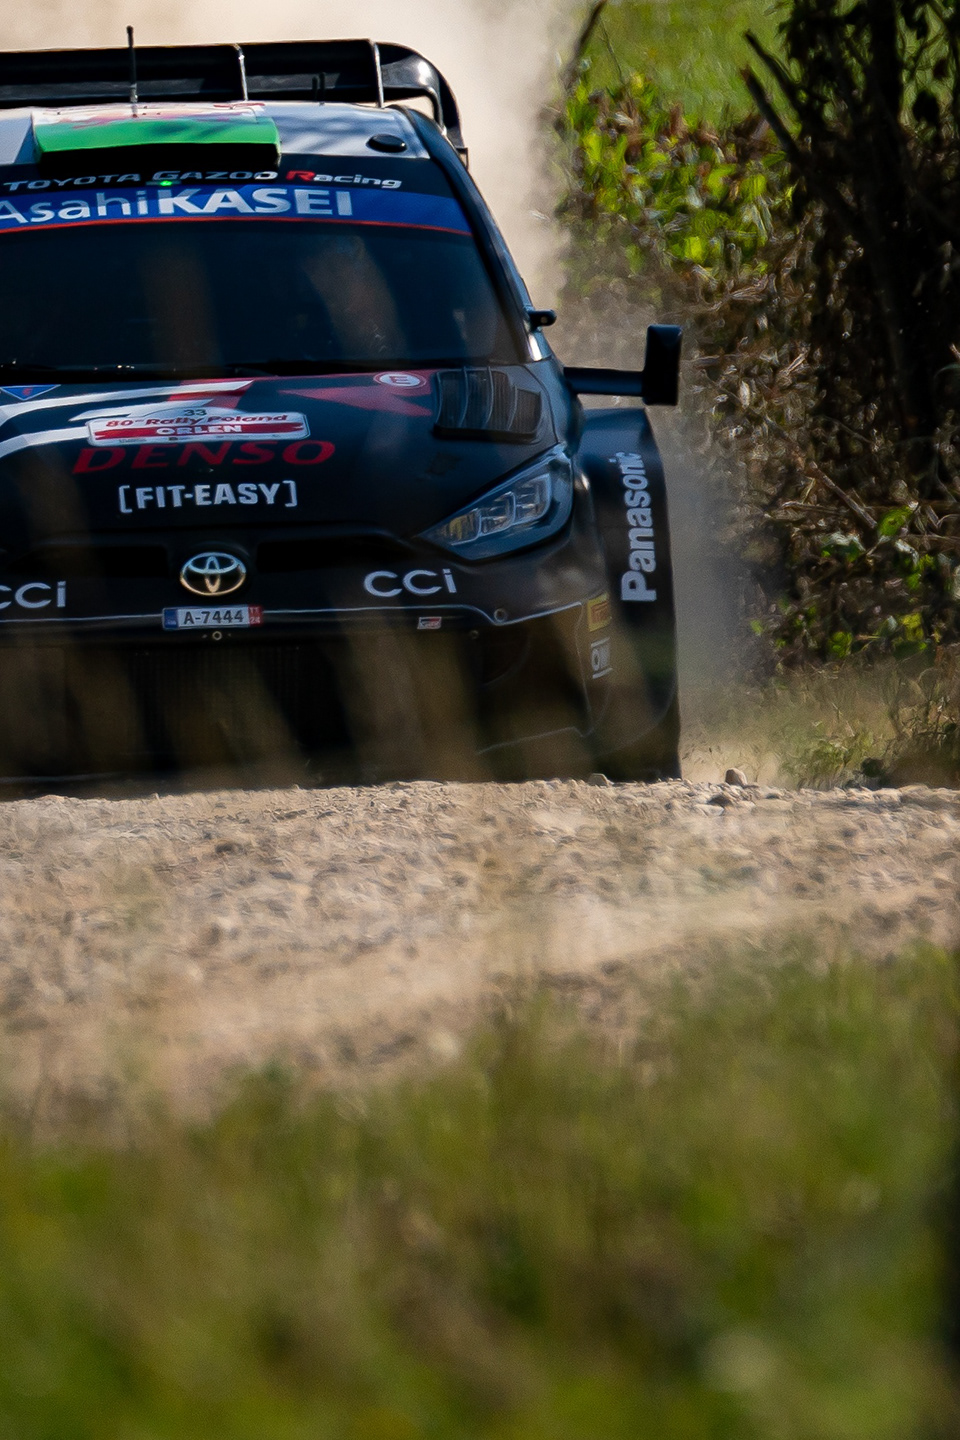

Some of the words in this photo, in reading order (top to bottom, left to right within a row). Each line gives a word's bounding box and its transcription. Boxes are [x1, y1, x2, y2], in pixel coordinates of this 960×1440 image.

[3, 173, 140, 191] TOYOTA
[152, 170, 279, 180] GAZOO
[286, 170, 402, 189] Racing
[144, 415, 203, 426] Rally
[207, 414, 288, 423] Poland
[184, 409, 208, 417] 33
[156, 425, 243, 435] ORLEN
[72, 440, 336, 474] DENSO
[609, 452, 657, 601] Panasonic
[184, 610, 244, 625] A-7444
